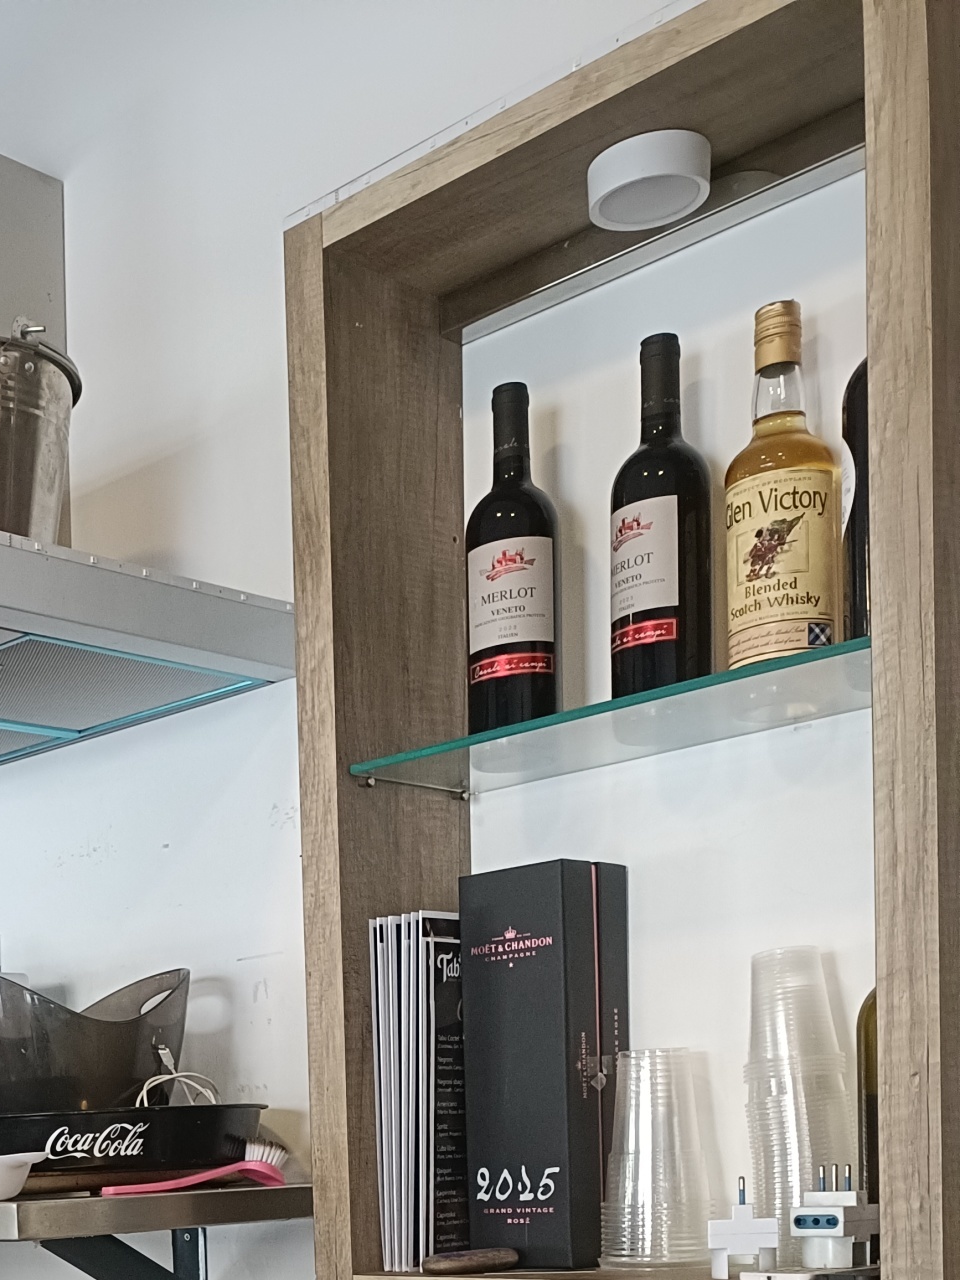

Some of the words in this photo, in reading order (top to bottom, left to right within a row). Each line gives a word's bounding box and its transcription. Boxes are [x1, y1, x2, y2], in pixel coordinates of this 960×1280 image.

[726, 500, 752, 530] Glen
[758, 486, 828, 516] Victory
[614, 573, 642, 590] VENETO
[745, 577, 797, 599] Blended
[481, 586, 536, 607] MERLOT
[730, 599, 761, 621] Scotch
[767, 591, 821, 608] Whisky
[491, 605, 526, 617] VENETO
[497, 944, 504, 952] &
[504, 936, 553, 952] CHANDON
[437, 951, 461, 983] Tab
[485, 950, 537, 962] CHAMPAGNE
[44, 1122, 150, 1160] Coca-Cola
[476, 1164, 561, 1202] 2015
